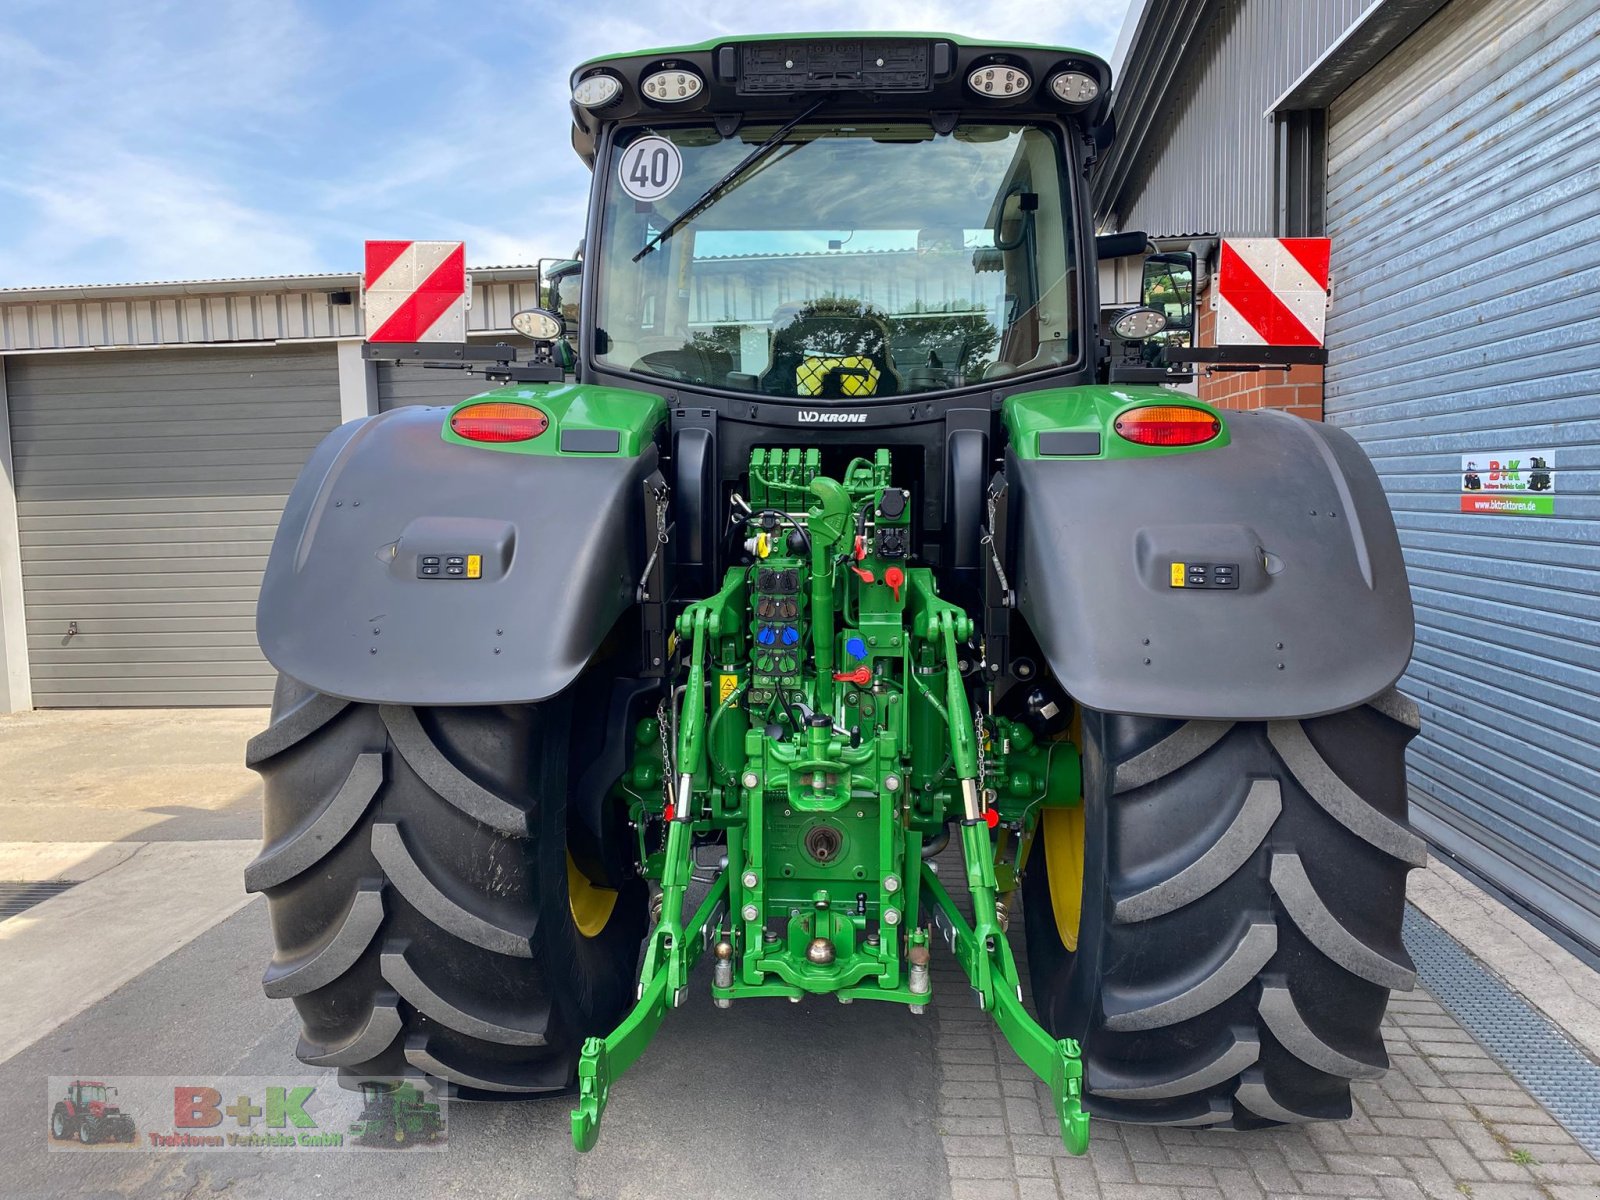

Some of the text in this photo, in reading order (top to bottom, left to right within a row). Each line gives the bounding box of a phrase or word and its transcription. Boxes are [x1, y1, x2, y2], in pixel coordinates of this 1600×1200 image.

[630, 148, 669, 188] 40
[819, 413, 868, 423] KRONE
[1489, 460, 1521, 481] B+K
